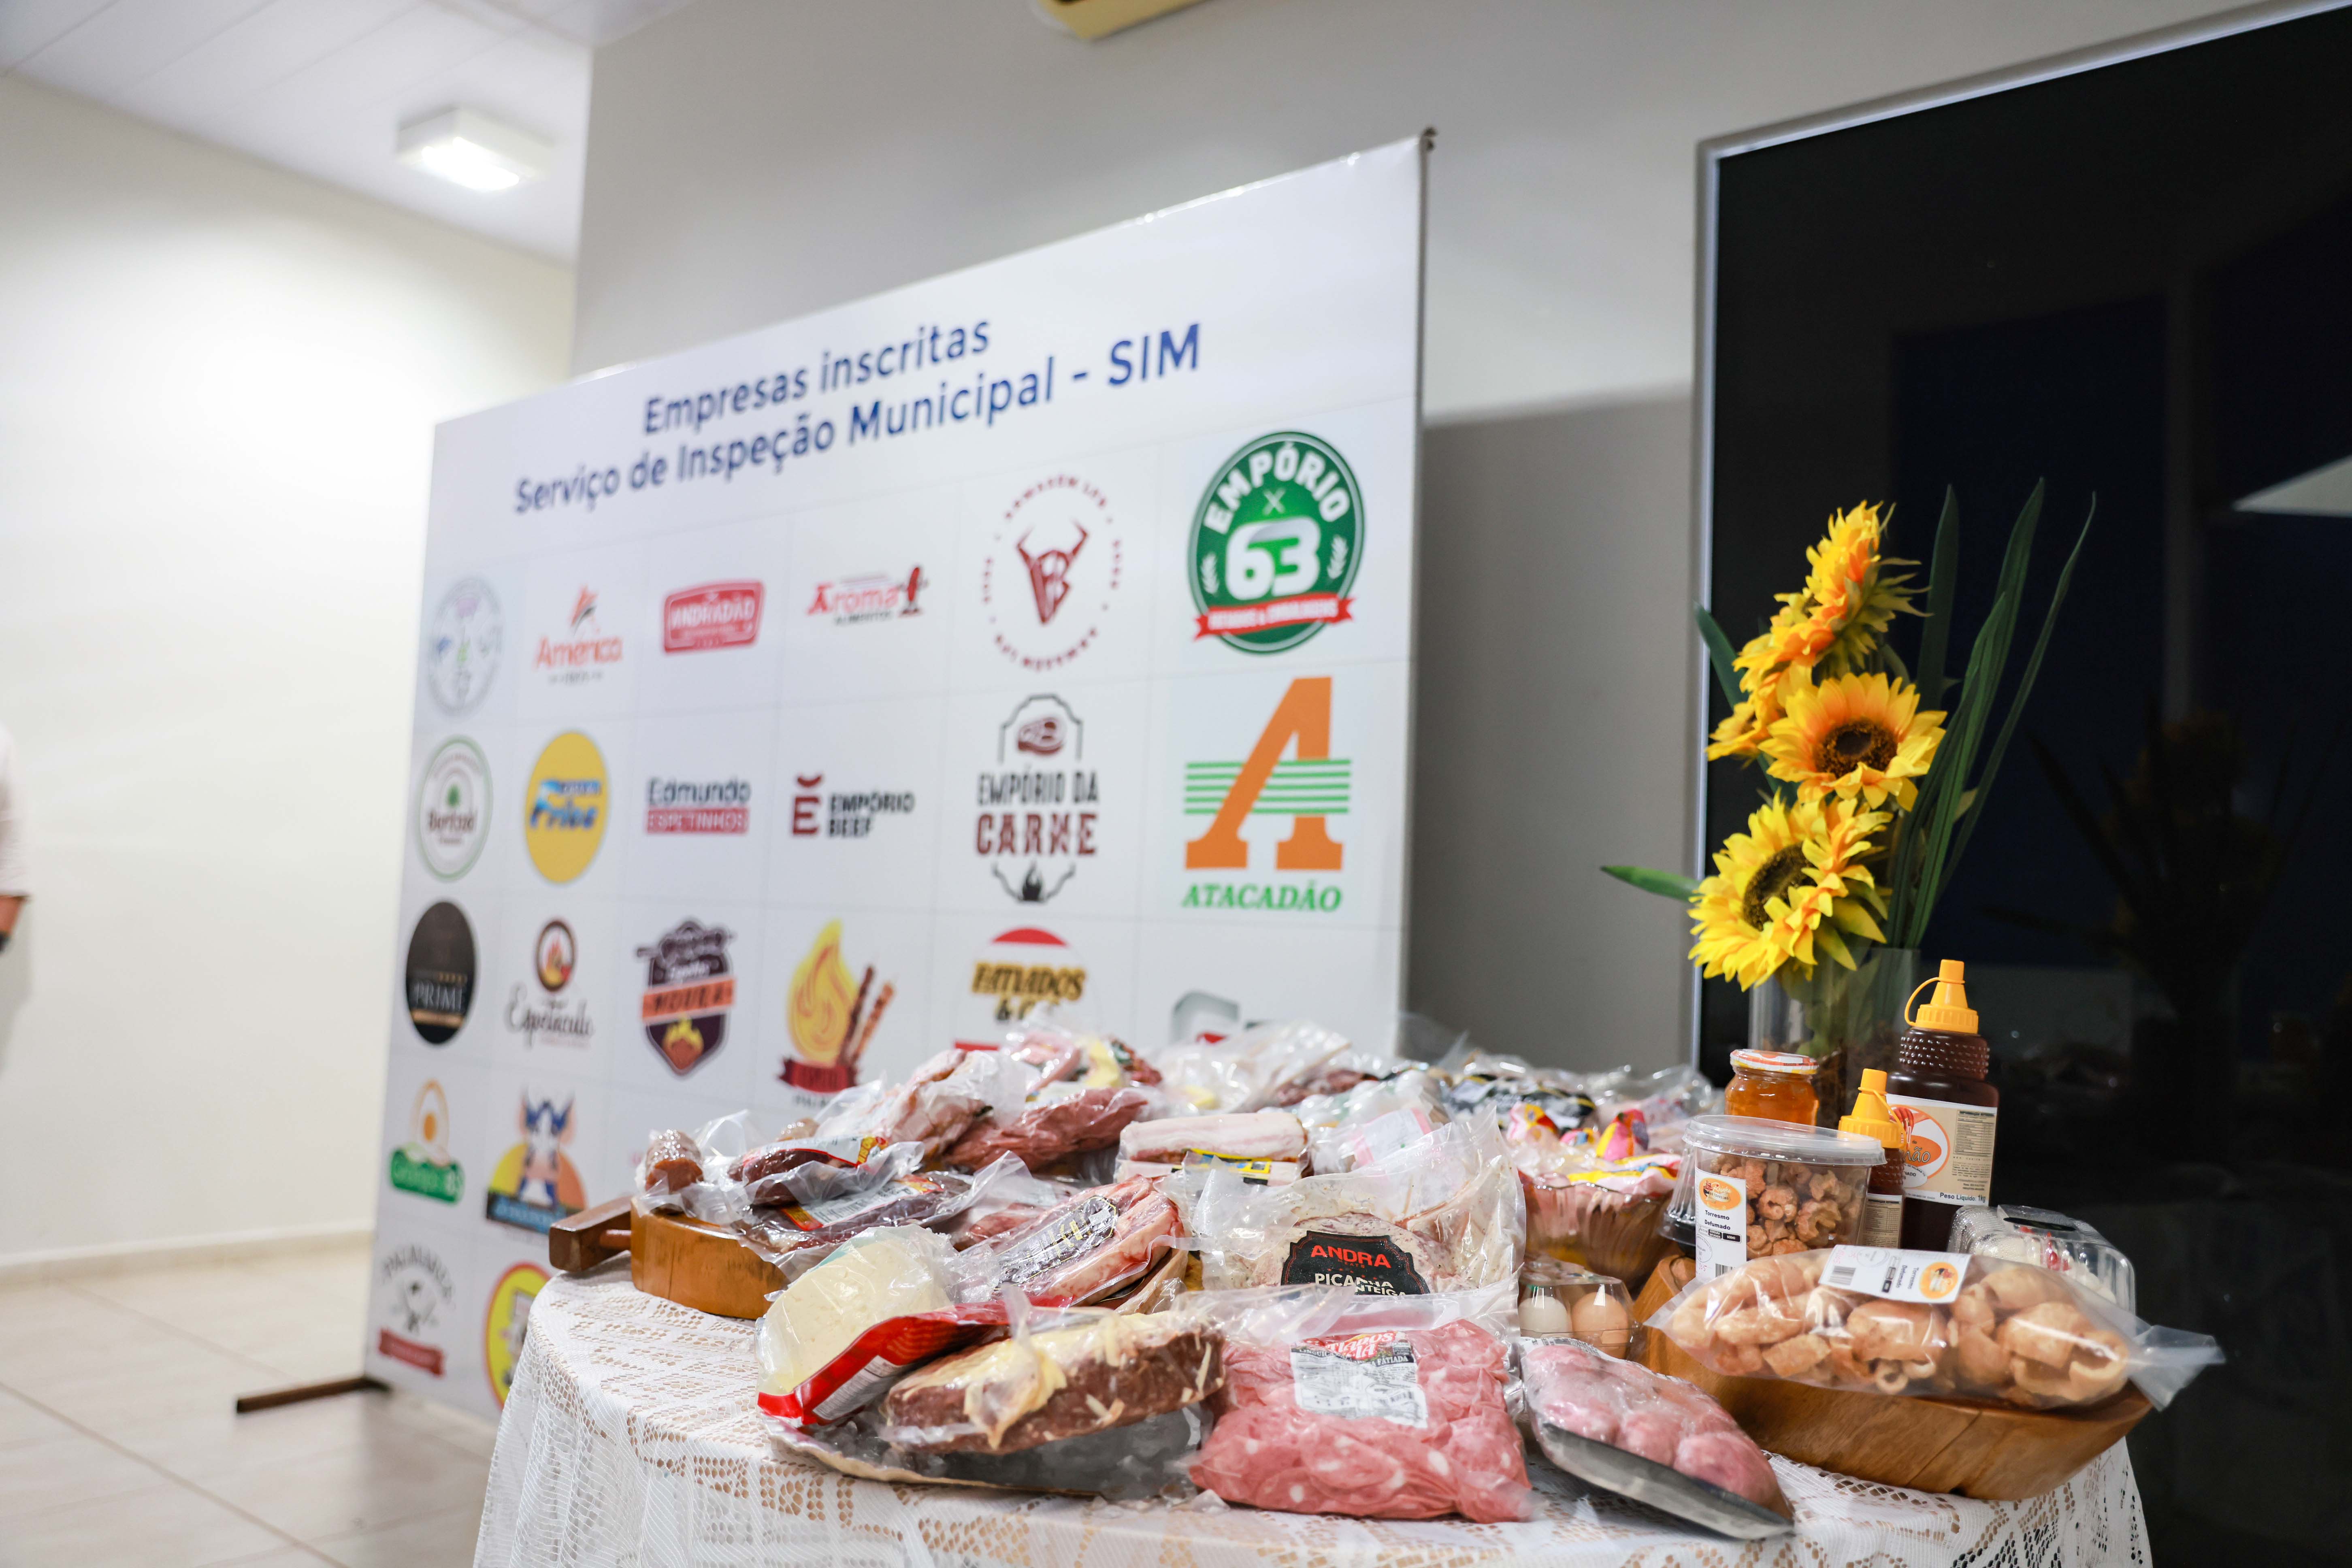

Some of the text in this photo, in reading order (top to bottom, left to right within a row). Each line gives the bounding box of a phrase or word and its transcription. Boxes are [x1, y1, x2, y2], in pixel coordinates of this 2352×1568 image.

[643, 319, 991, 436] Empresas inscritas
[515, 323, 1202, 515] Serviço de Inspeção Municipal - SIM
[1202, 441, 1351, 535] EMPÓRIO
[1225, 517, 1321, 600] 63
[648, 777, 752, 804] Edmundo
[977, 767, 1099, 806] EMPÓRIO DA
[829, 817, 872, 837] BEEF
[976, 812, 1098, 856] CARNE
[1181, 880, 1342, 912] ATACADÃO
[1978, 1195, 1986, 1203] 1kg
[1704, 1219, 1730, 1230] Defumado
[1705, 1210, 1730, 1220] Torresmo
[1311, 1245, 1391, 1268] ANDRA
[1338, 1259, 1365, 1269] MEATS
[1895, 1264, 1908, 1289] Defumado
[1908, 1267, 1920, 1290] Torresmo
[1355, 1285, 1406, 1296] NTEIGA
[1377, 1356, 1409, 1366] FATIADA
